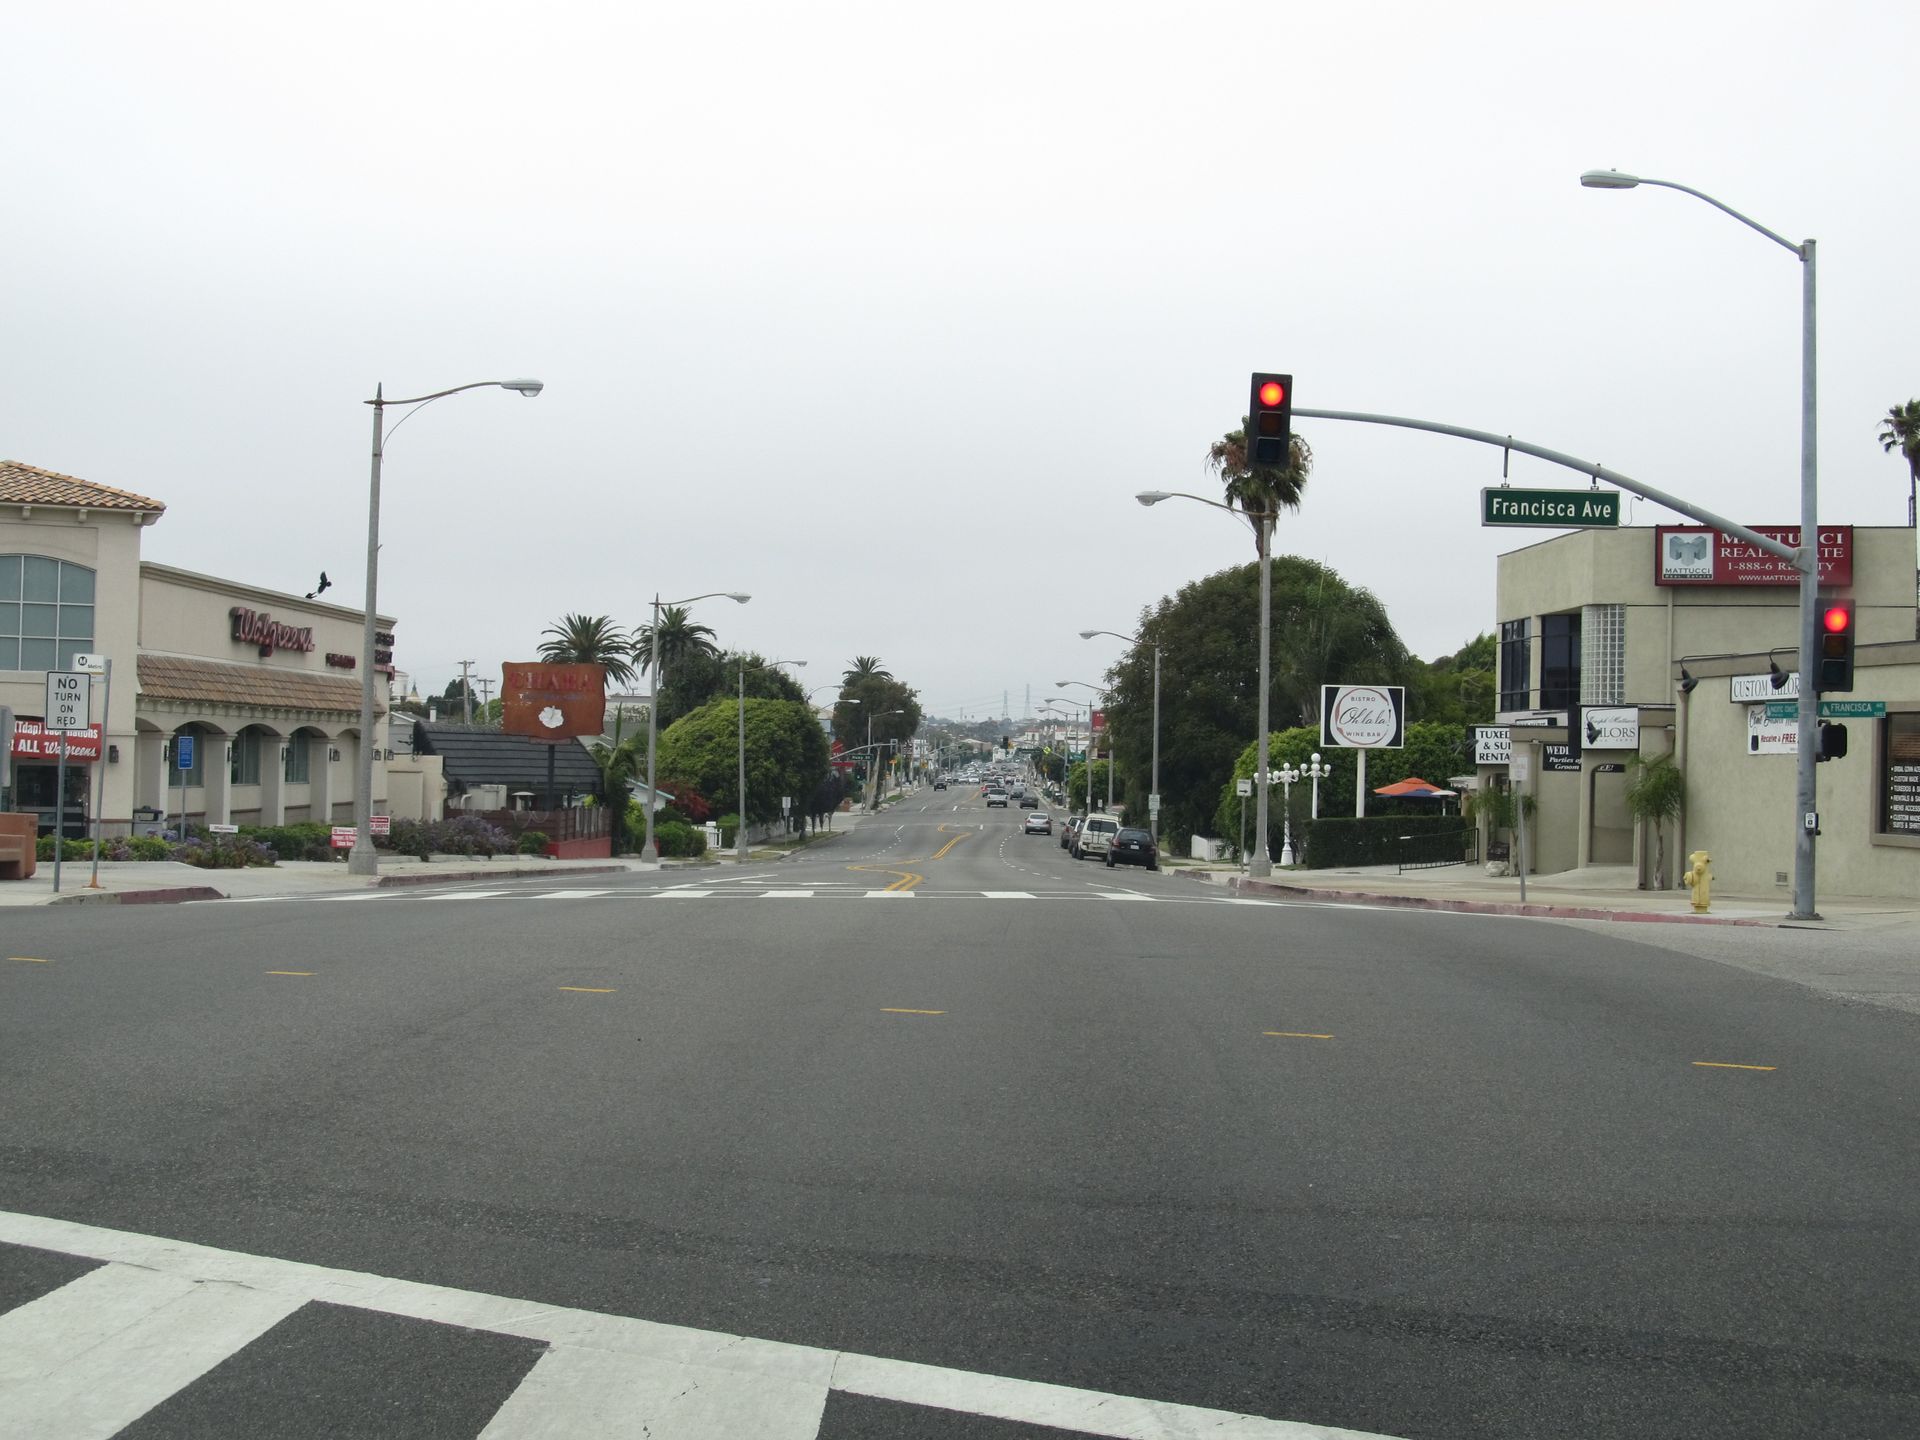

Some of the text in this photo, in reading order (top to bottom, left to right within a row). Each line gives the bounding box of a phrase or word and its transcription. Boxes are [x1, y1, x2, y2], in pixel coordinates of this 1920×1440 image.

[1492, 498, 1611, 518] Francisca Ave
[1720, 548, 1768, 557] REAL
[1728, 562, 1773, 570] 1-888-6
[231, 607, 316, 657] Walgreens
[57, 678, 78, 689] NO
[1733, 680, 1768, 697] CUSTOM
[54, 692, 81, 702] TURN
[60, 704, 73, 713] ON
[1830, 703, 1872, 712] FRANCISCA
[56, 716, 77, 725] RED
[1339, 707, 1368, 725] Oh
[14, 720, 42, 735] (Tdap)
[1760, 735, 1777, 743] Receive
[1782, 733, 1796, 743] FREE
[18, 739, 40, 753] ALL
[1483, 741, 1491, 750] &
[1479, 752, 1510, 761] RENTA
